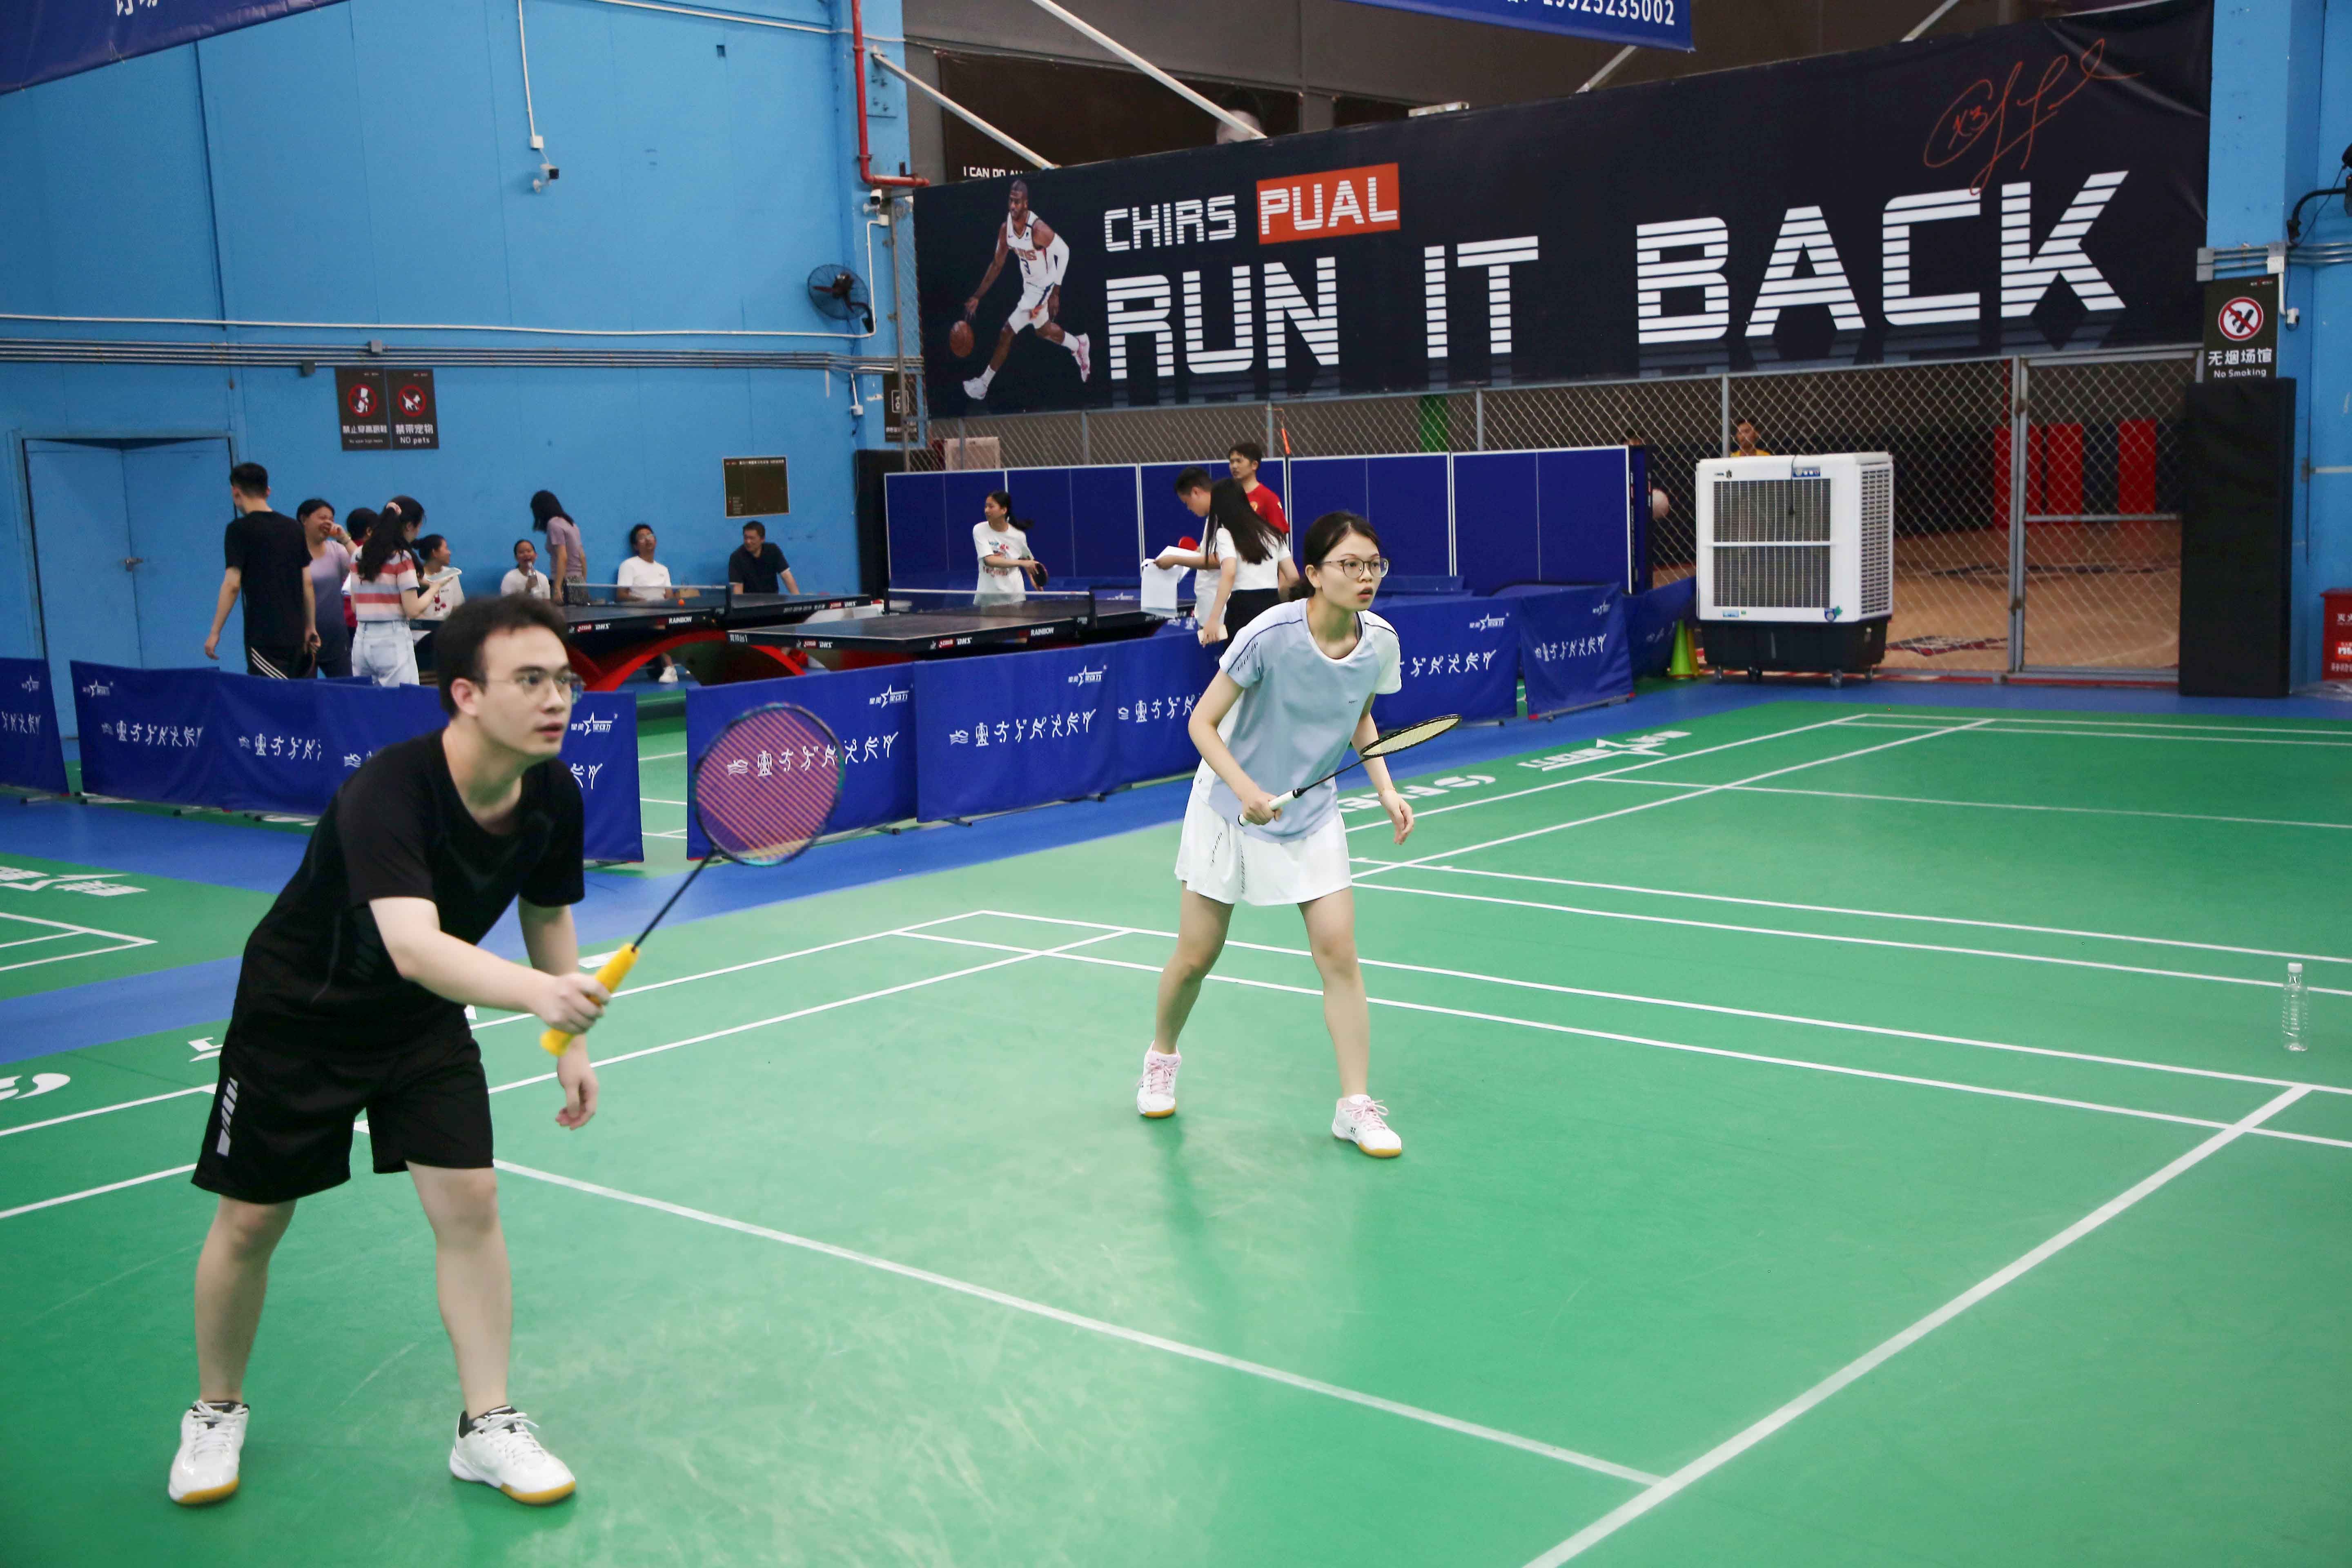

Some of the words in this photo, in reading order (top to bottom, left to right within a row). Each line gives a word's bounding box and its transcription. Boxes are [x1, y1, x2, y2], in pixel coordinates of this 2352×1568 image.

[969, 167, 990, 178] CAN
[1105, 195, 1236, 252] CHIRS
[1260, 177, 1398, 235] PUAL
[1106, 256, 1339, 380] RUN
[1425, 236, 1539, 359] IT
[1637, 171, 2128, 344] BACK
[2208, 347, 2272, 366] 无烟场馆
[2214, 370, 2227, 378] No
[2228, 368, 2267, 378] Smoking
[668, 616, 693, 624] RAINBOW
[1030, 627, 1054, 636] RAINBOW
